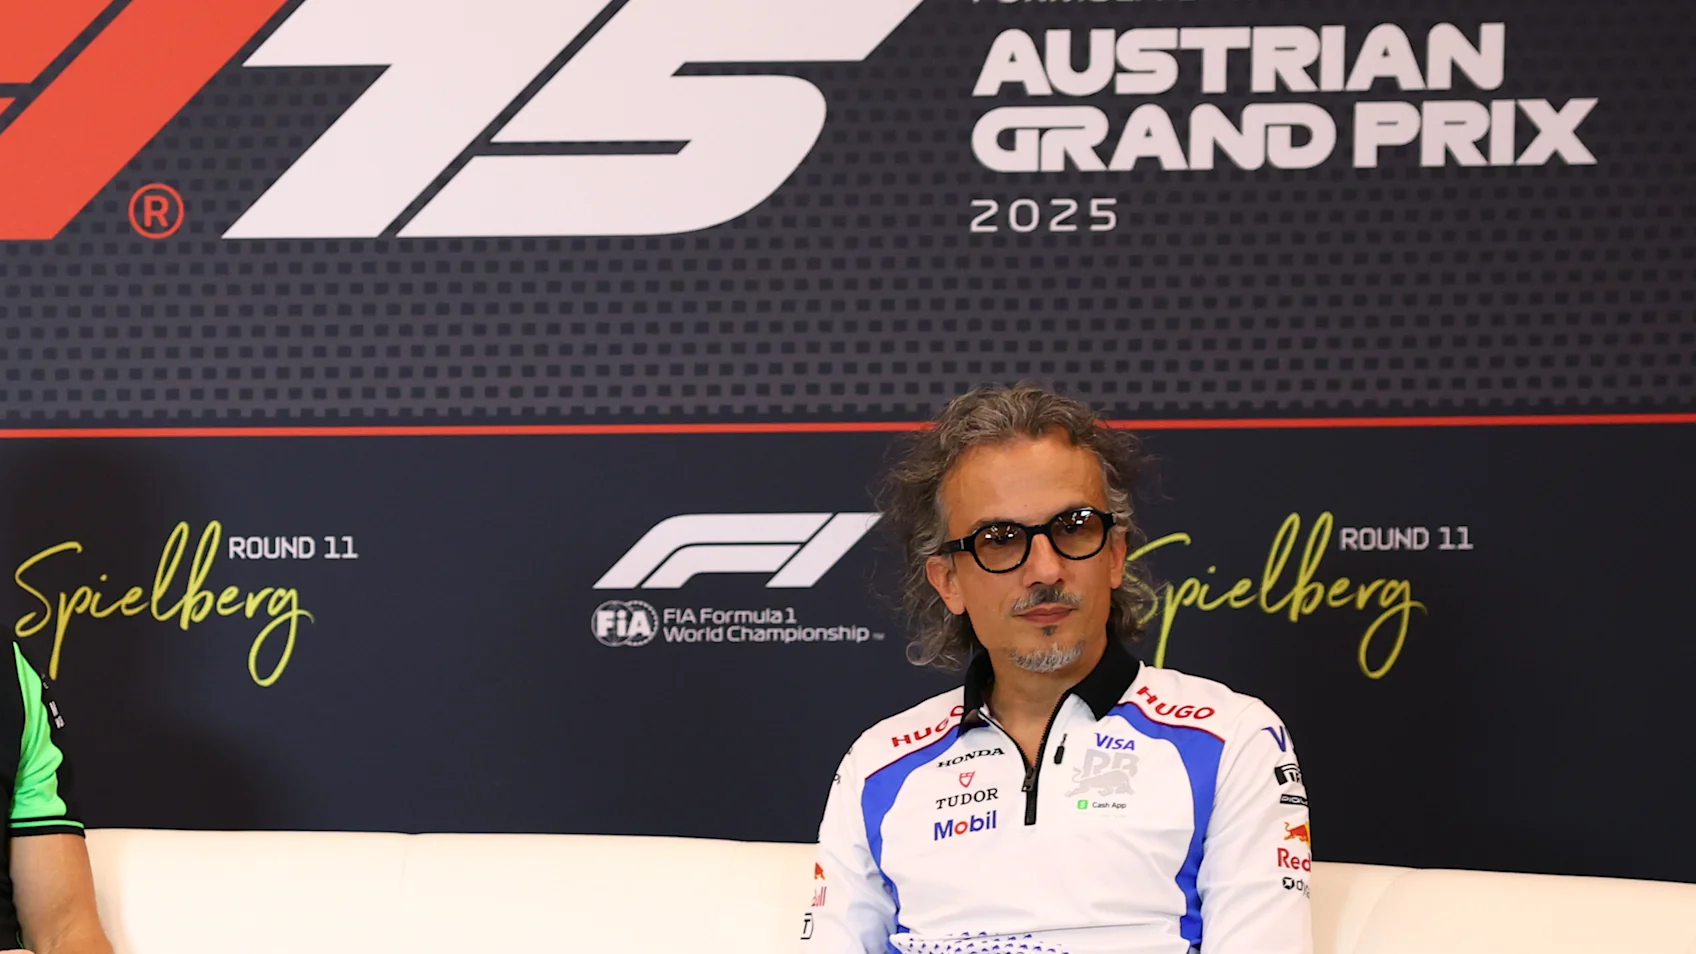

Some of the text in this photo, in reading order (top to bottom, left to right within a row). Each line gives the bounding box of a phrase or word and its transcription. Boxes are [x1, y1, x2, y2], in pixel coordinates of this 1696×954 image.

[971, 22, 1506, 96] AUSTRIAN
[971, 97, 1599, 172] GRAND PRIX
[969, 198, 1118, 232] 2025
[229, 536, 359, 559] ROUND 11
[592, 512, 886, 589] F1
[1340, 526, 1474, 551] ROUND 11
[14, 520, 315, 687] Spielberg
[1123, 511, 1428, 680] Spielberg
[663, 608, 797, 624] FIA Formula 1
[663, 626, 723, 643] World
[727, 625, 870, 644] Championship
[1136, 686, 1215, 719] HUGO
[891, 705, 965, 747] HUGO
[1094, 733, 1135, 750] VISA
[937, 747, 1005, 768] HONDA
[935, 788, 999, 810] TUDOR
[934, 810, 997, 841] Mobil
[1277, 847, 1311, 872] Red
